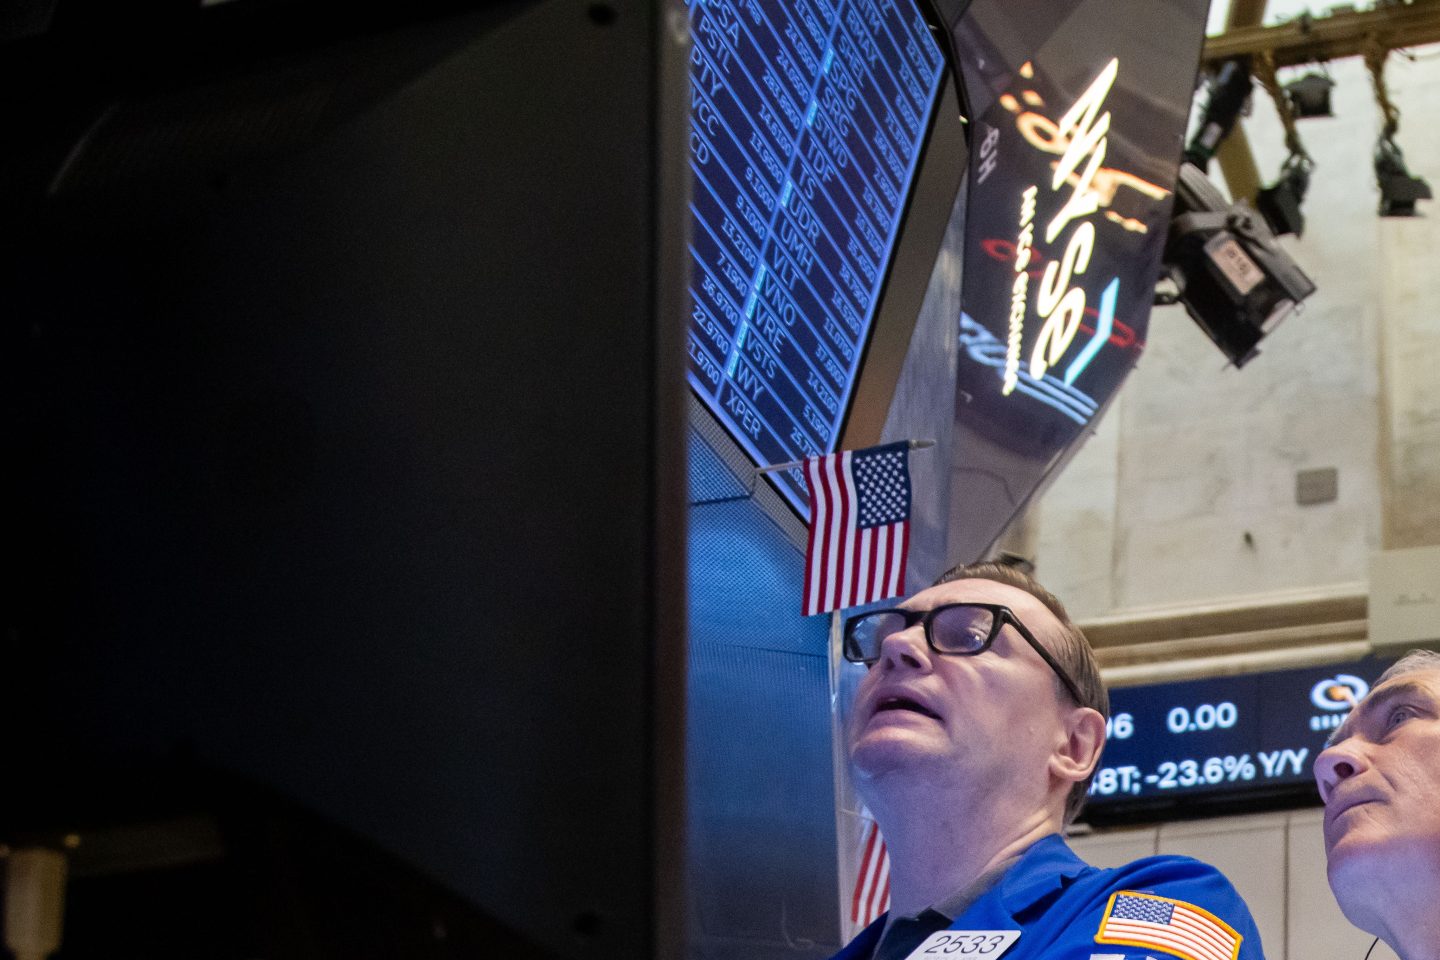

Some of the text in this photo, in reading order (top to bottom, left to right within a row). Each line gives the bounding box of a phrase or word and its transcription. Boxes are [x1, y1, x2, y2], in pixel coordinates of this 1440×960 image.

[699, 15, 733, 74] PSTL
[838, 33, 866, 87] SHEL
[846, 8, 877, 69] RMAX
[688, 44, 721, 102] PTY
[830, 59, 857, 114] SPG
[689, 87, 718, 138] VCC
[822, 84, 850, 140] SRG
[688, 130, 710, 169] CD
[805, 137, 833, 189] TDF
[814, 110, 848, 172] STWD
[796, 164, 816, 203] TS
[721, 216, 755, 269] 13.2100
[788, 190, 819, 246] UDR
[771, 245, 798, 293] VLT
[779, 218, 813, 276] UMH
[702, 274, 737, 327] 36.9700
[717, 252, 746, 298] 7.1900
[762, 273, 796, 330] VNO
[692, 304, 728, 355] 22.9700
[753, 302, 785, 354] VRE
[745, 331, 776, 381] VSTS
[726, 389, 761, 441] XPER
[735, 360, 814, 462] WY 25.71
[1167, 702, 1238, 733] 0.00
[1145, 754, 1256, 788] -23.6%
[1258, 748, 1309, 777] Y/Y
[924, 935, 1005, 954] 2533
